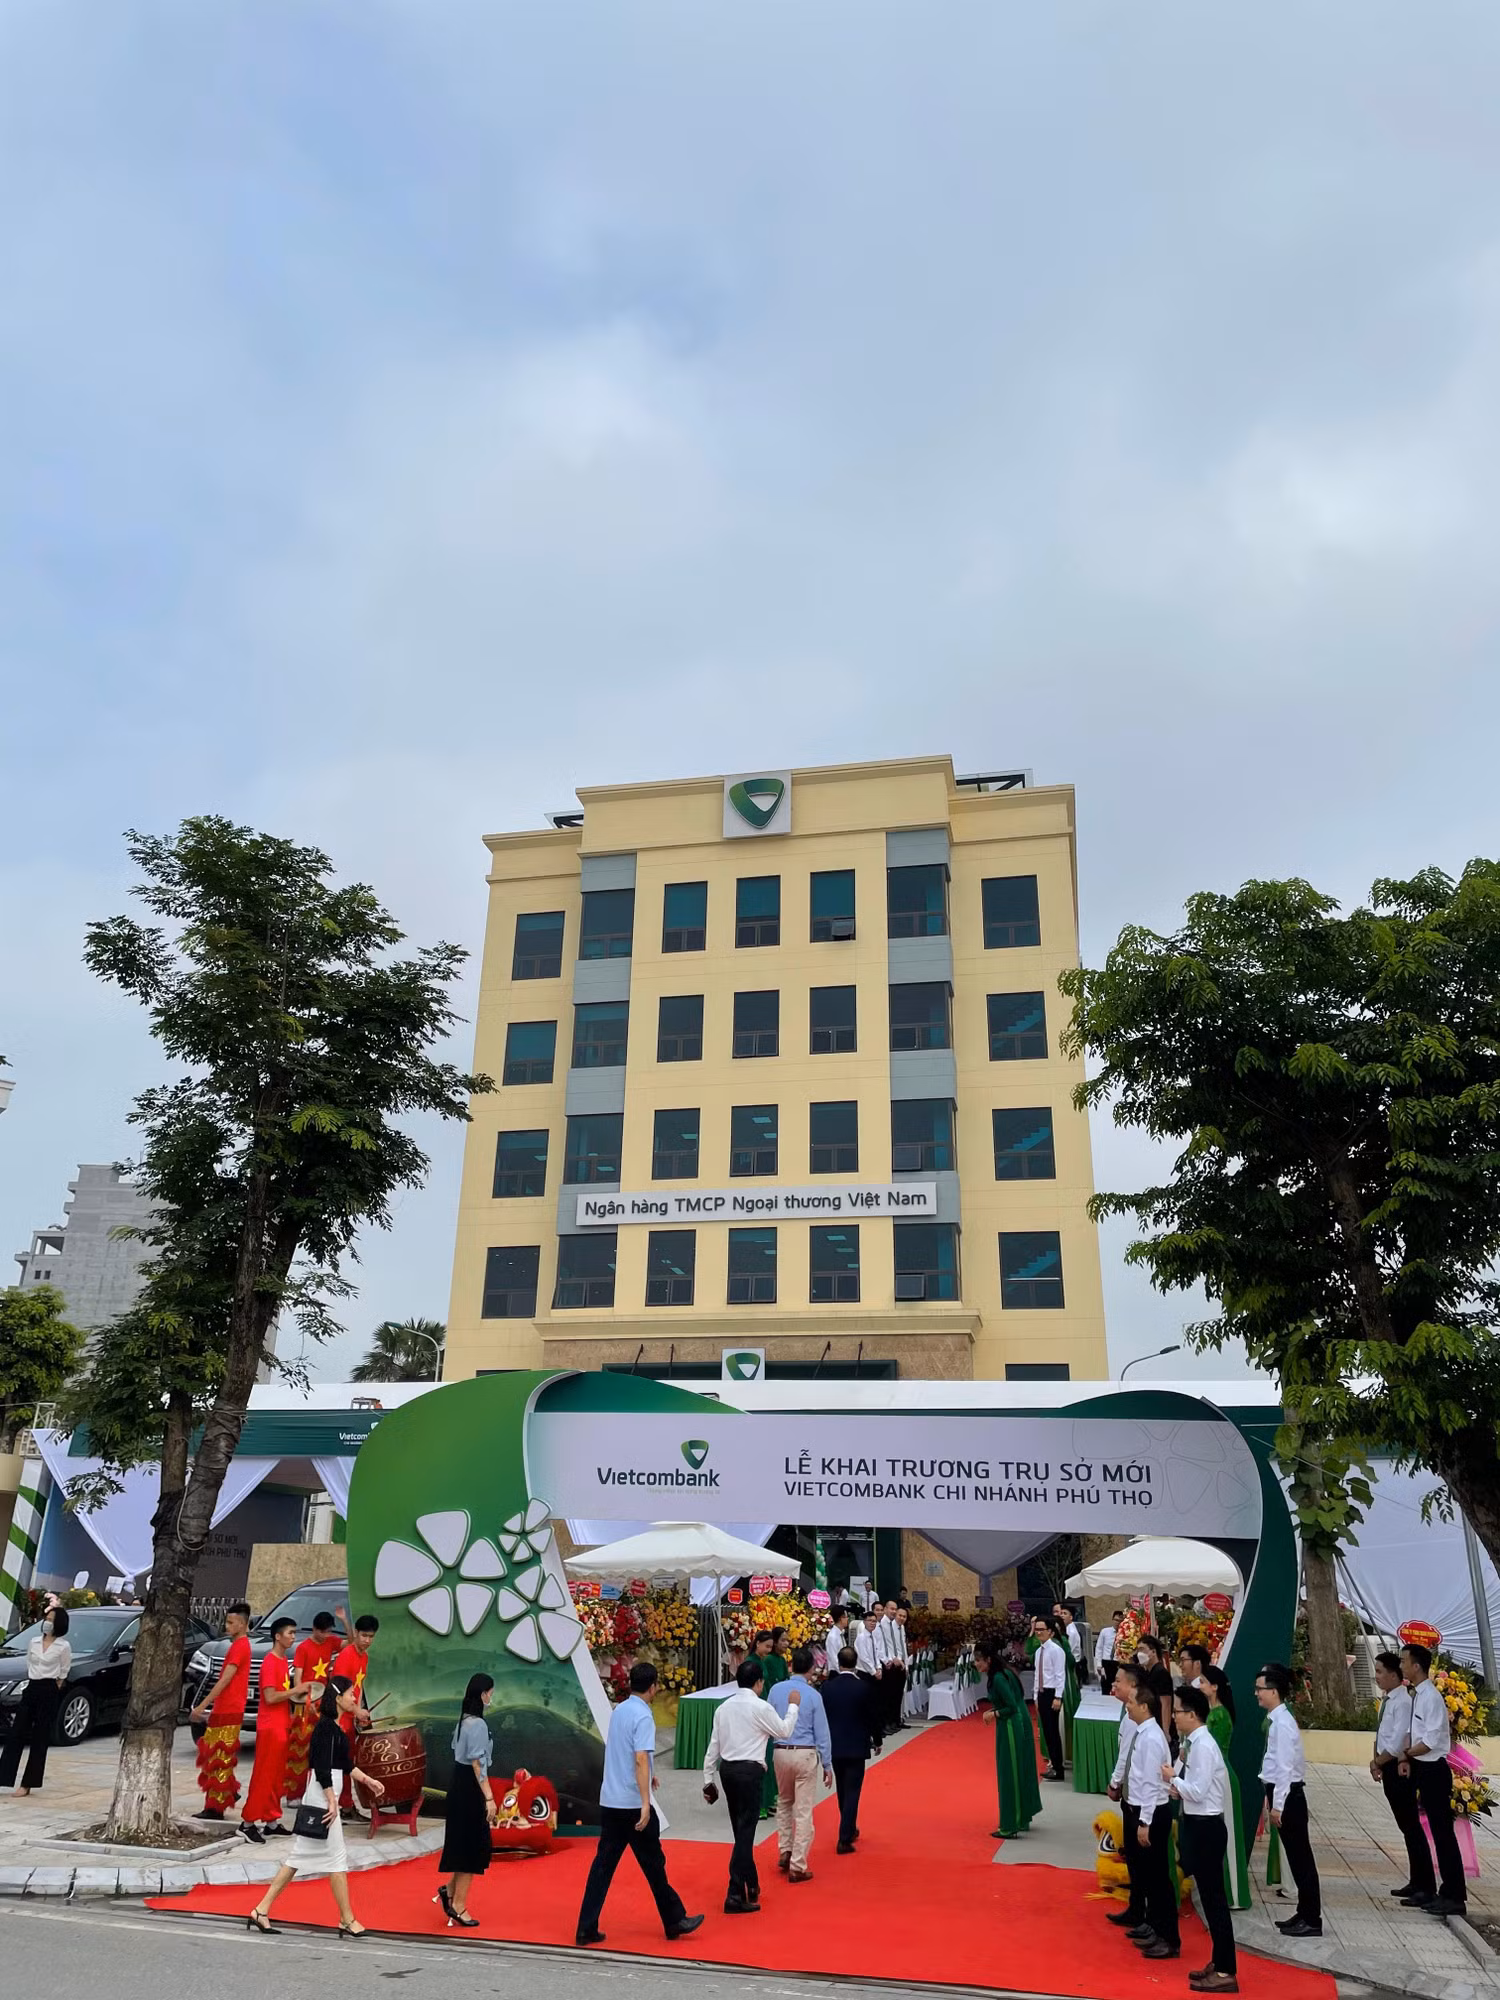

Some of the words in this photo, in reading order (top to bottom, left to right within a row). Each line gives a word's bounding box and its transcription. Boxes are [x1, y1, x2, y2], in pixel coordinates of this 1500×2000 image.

[584, 1201, 625, 1218] Ngân
[631, 1200, 668, 1216] hàng
[674, 1197, 726, 1212] TMCP
[732, 1195, 778, 1213] Ngoại
[784, 1194, 842, 1211] thương
[848, 1191, 881, 1209] Việt
[888, 1191, 927, 1207] Nam
[597, 1467, 720, 1487] Vietcombank
[785, 1449, 812, 1475] LỄ
[821, 1457, 877, 1477] KHAI
[886, 1459, 990, 1479] TRƯƠNG
[999, 1461, 1050, 1485] TRỤ
[1060, 1457, 1093, 1482] SỞ
[1102, 1459, 1152, 1483] MỚI
[784, 1481, 926, 1499] VIETCOMBANK
[933, 1485, 966, 1501] CHI
[974, 1483, 1048, 1503] NHÁNH
[1056, 1485, 1101, 1504] PHÚ
[1107, 1489, 1153, 1509] THỌ
